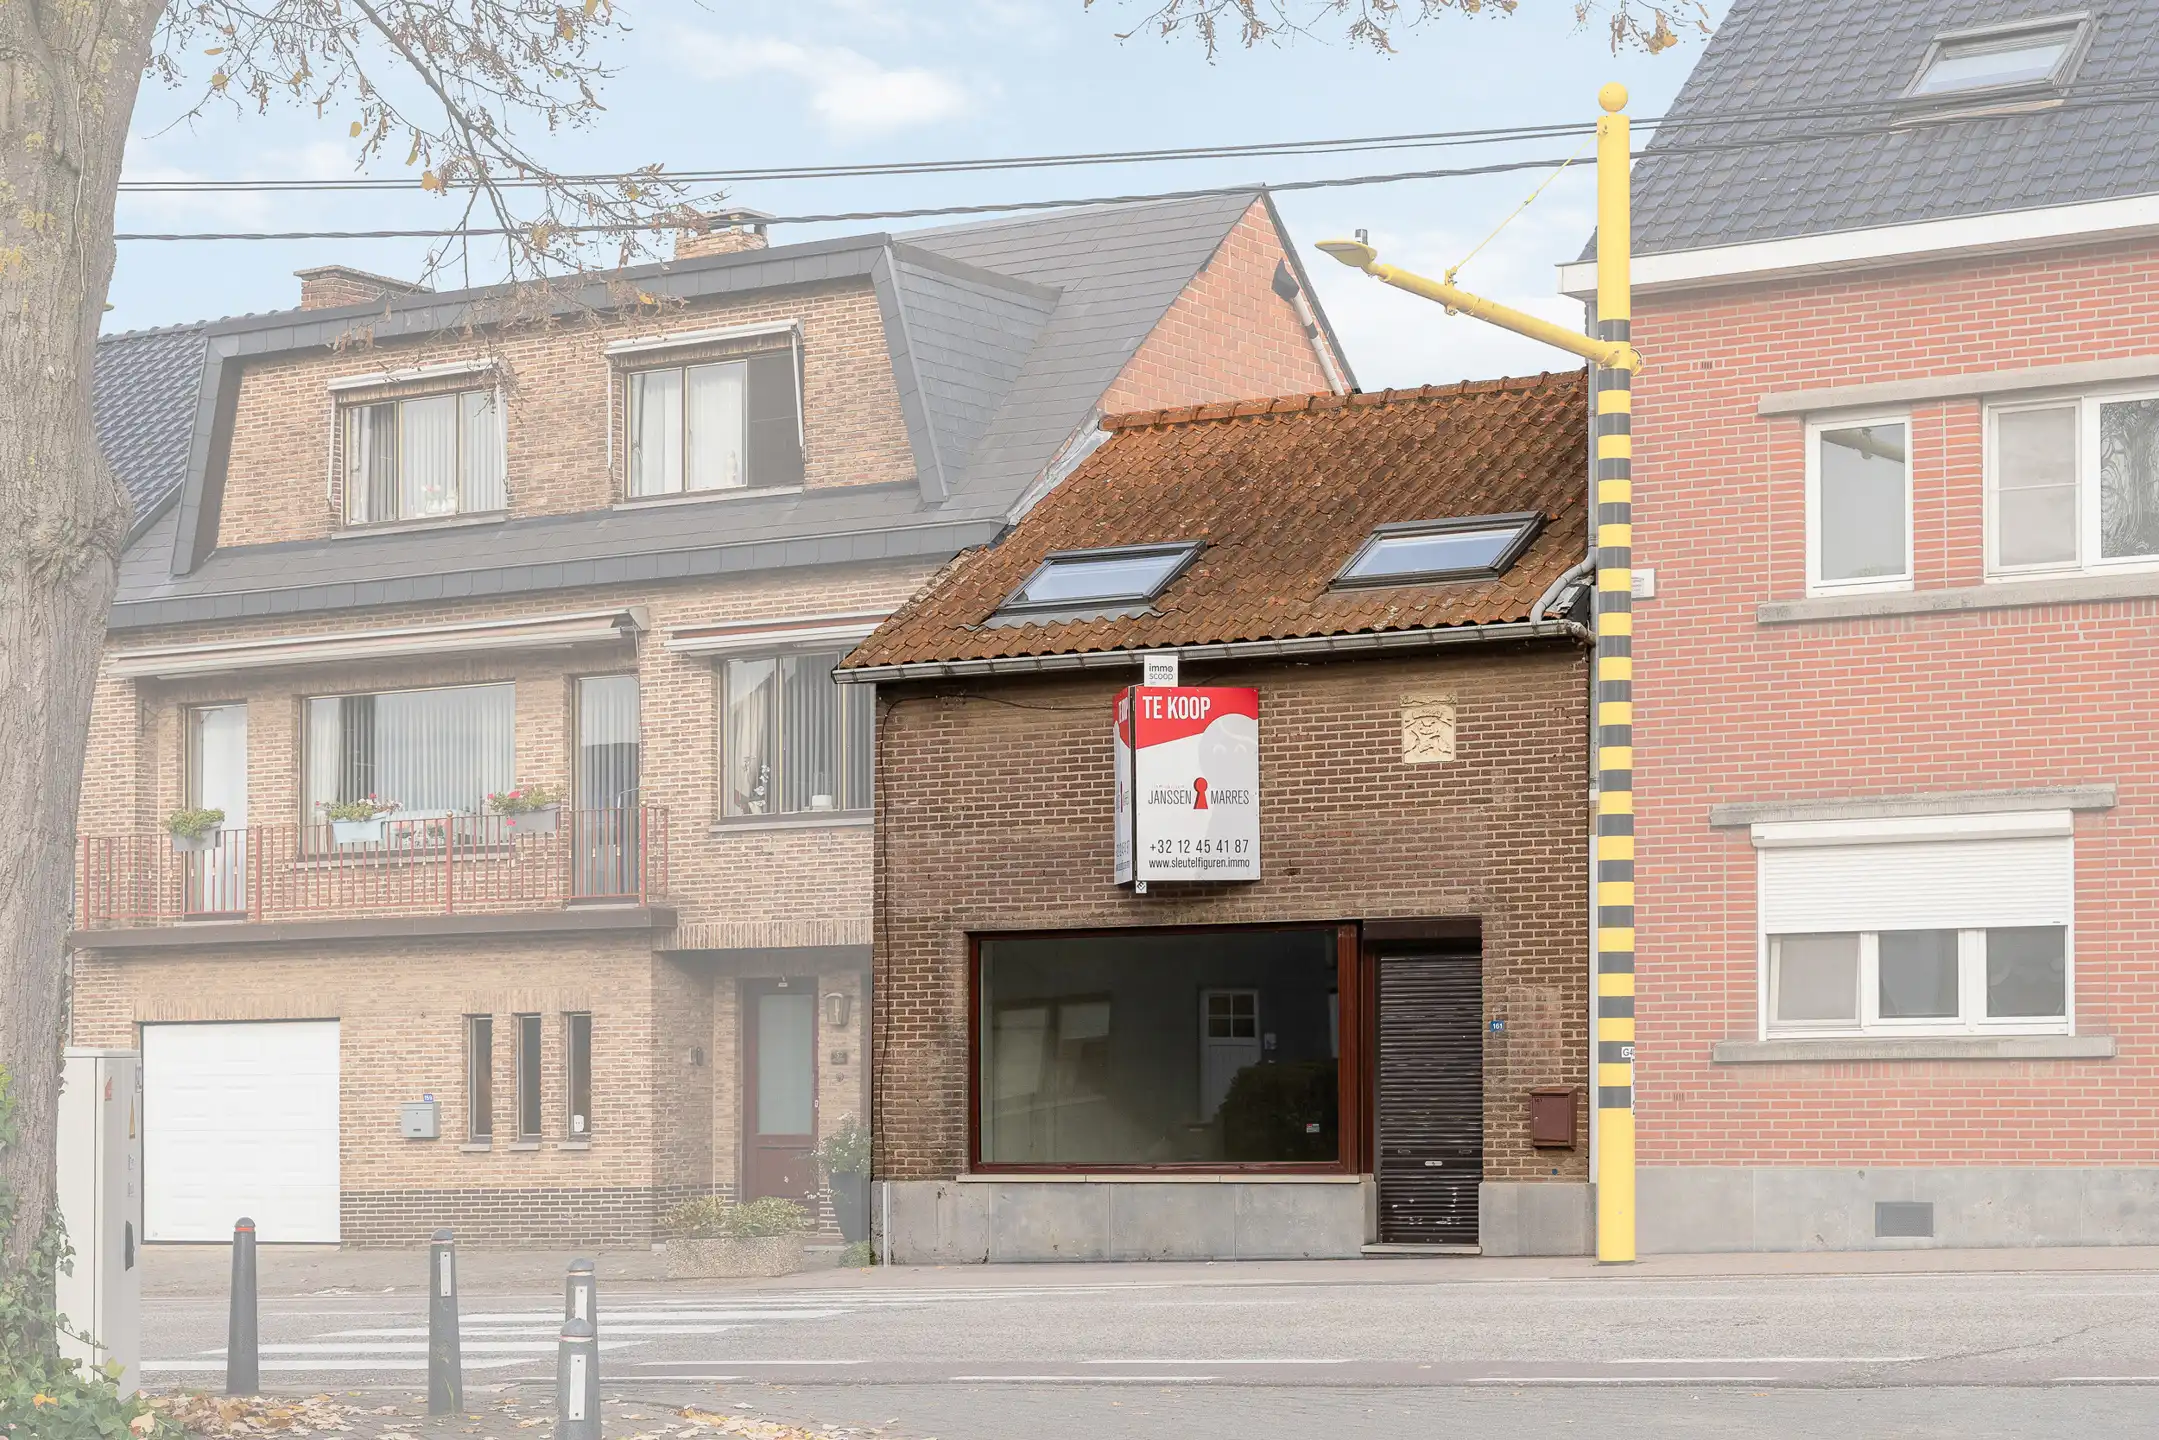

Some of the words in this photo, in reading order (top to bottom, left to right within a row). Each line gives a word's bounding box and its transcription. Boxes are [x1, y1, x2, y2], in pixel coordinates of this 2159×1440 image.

[1148, 663, 1174, 672] immo
[1148, 673, 1174, 681] scoop
[1142, 695, 1163, 719] TE
[1167, 696, 1211, 720] KOOP
[1147, 789, 1192, 805] JANSSEN
[1210, 789, 1250, 805] MARRES
[1149, 839, 1172, 854] +32
[1177, 839, 1191, 854] 12
[1195, 839, 1211, 854] 45
[1216, 839, 1229, 854] 41
[1234, 839, 1249, 854] 87
[1148, 857, 1250, 870] www.sleutelfiguren.immo
